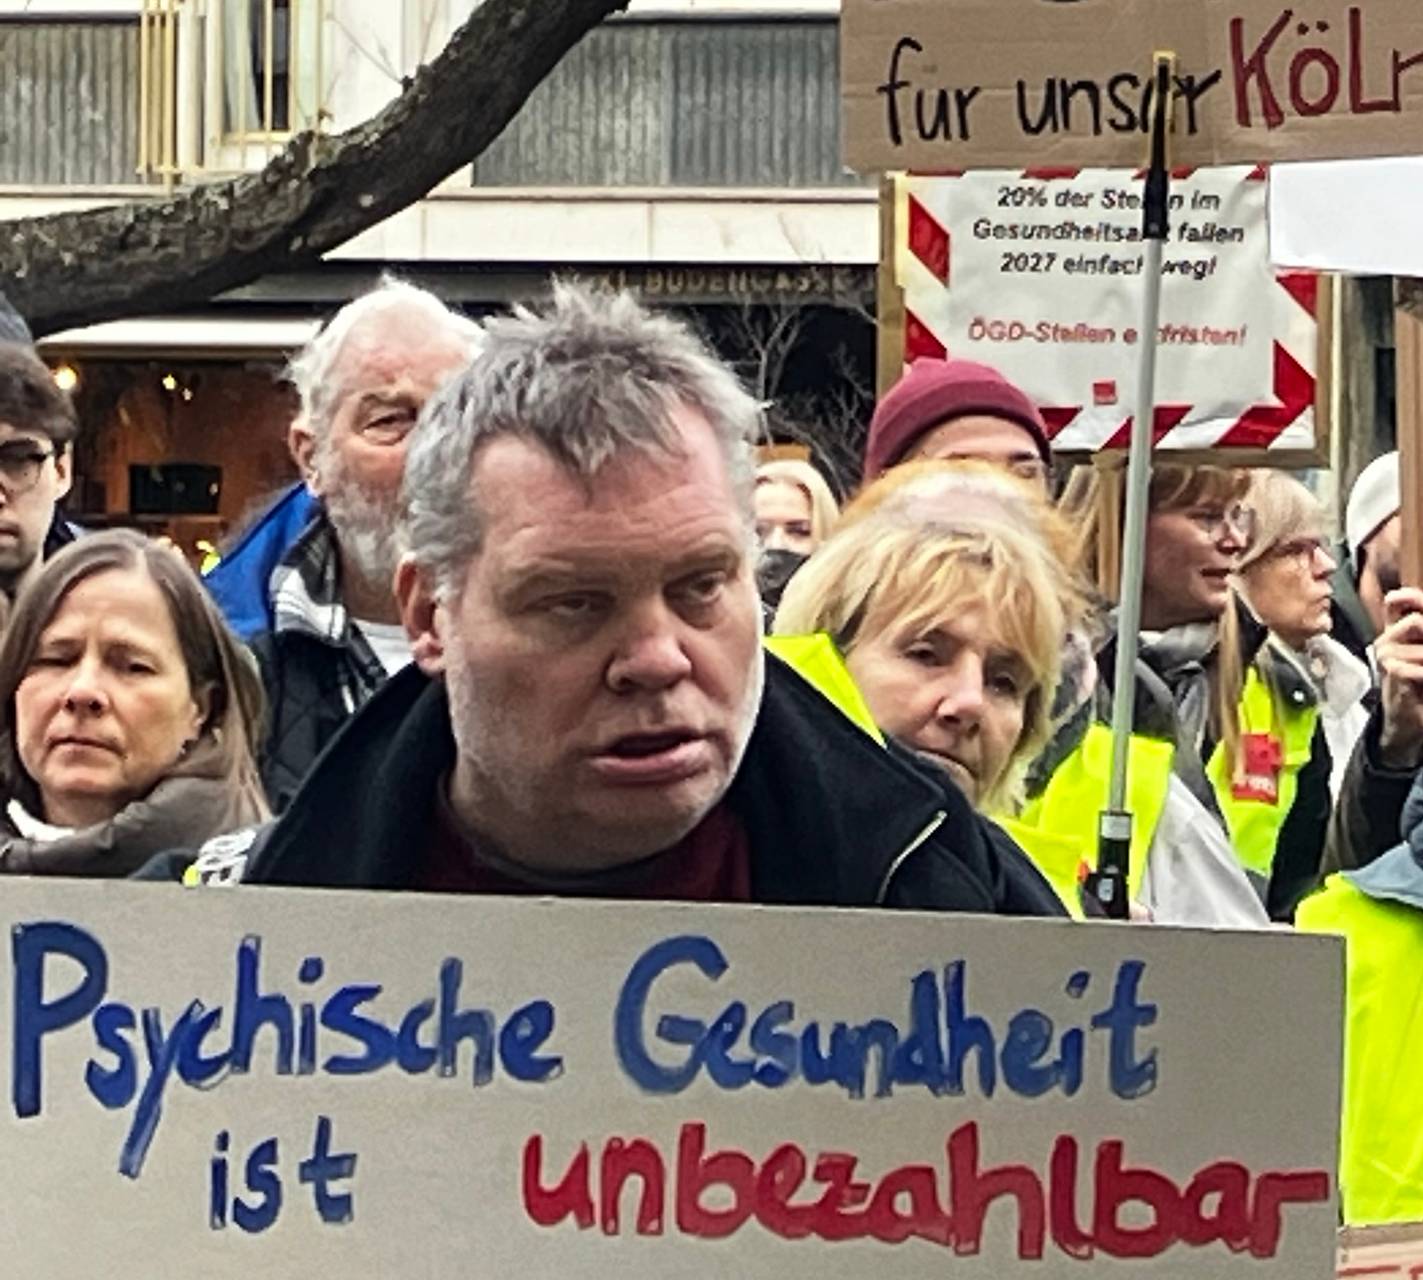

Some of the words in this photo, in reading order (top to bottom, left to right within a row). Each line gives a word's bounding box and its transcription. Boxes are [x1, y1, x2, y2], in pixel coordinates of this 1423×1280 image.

[997, 186, 1048, 208] 20%
[1055, 188, 1094, 210] der
[1100, 188, 1184, 211] Sten
[1190, 190, 1221, 210] im
[1177, 222, 1245, 244] fallen
[1000, 251, 1056, 273] 2027
[968, 316, 1117, 344] ÖGD-Stellen
[11, 920, 564, 1179] Psychische
[614, 934, 1158, 1101] Gesundheit
[208, 1114, 358, 1234] ist
[521, 1120, 1330, 1262] unbezahlbar
